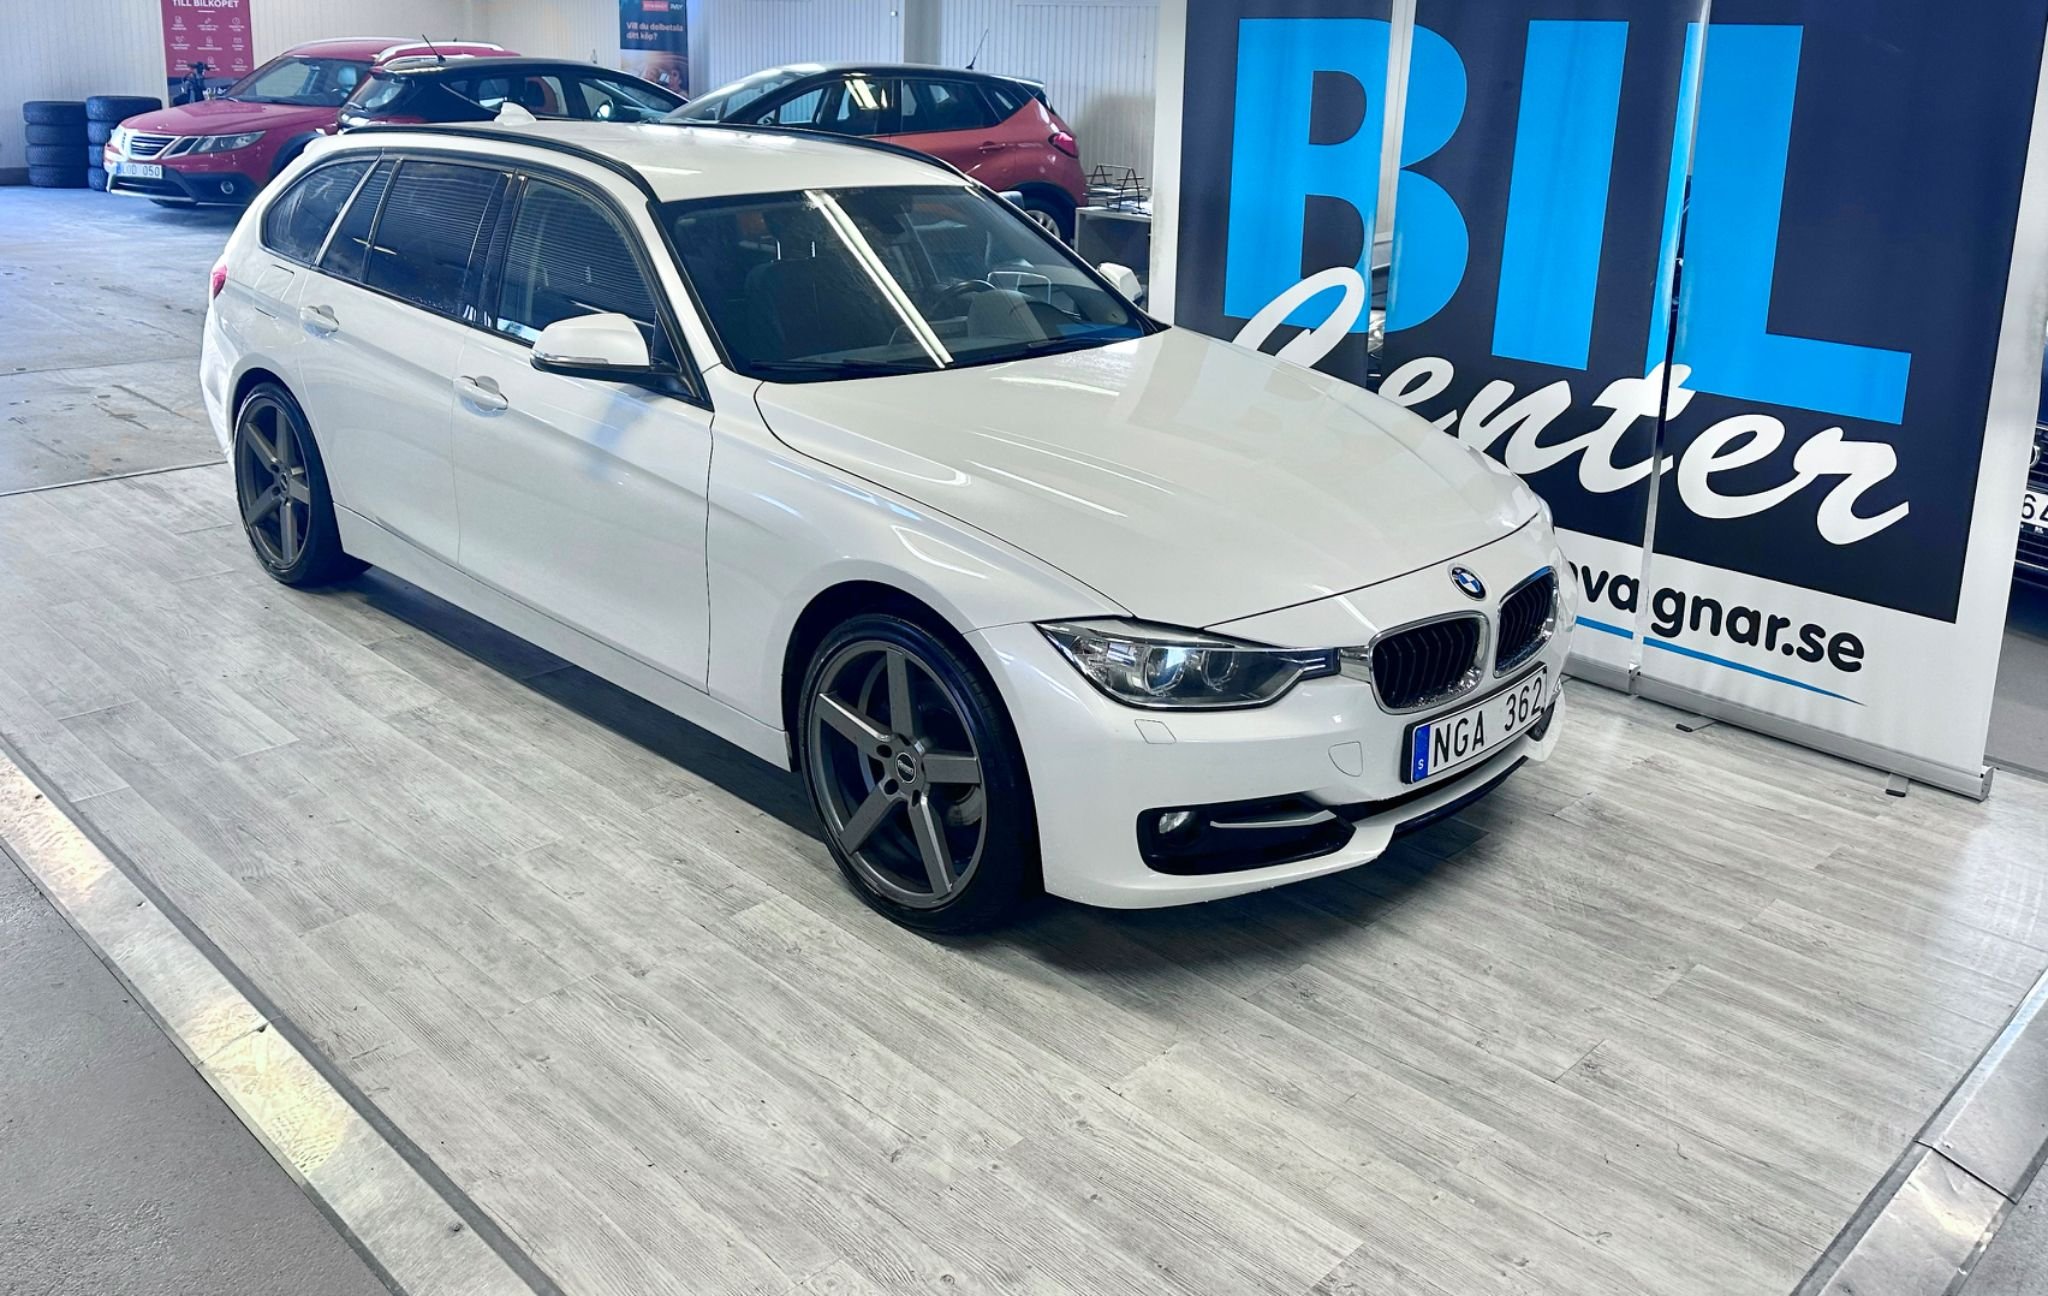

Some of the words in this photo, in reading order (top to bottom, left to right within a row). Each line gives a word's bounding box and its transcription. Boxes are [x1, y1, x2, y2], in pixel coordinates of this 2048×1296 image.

[1225, 18, 1912, 425] BIL
[1567, 560, 1865, 673] vagnar.se
[1433, 709, 1485, 768] NGA
[1504, 677, 1543, 732] 362
